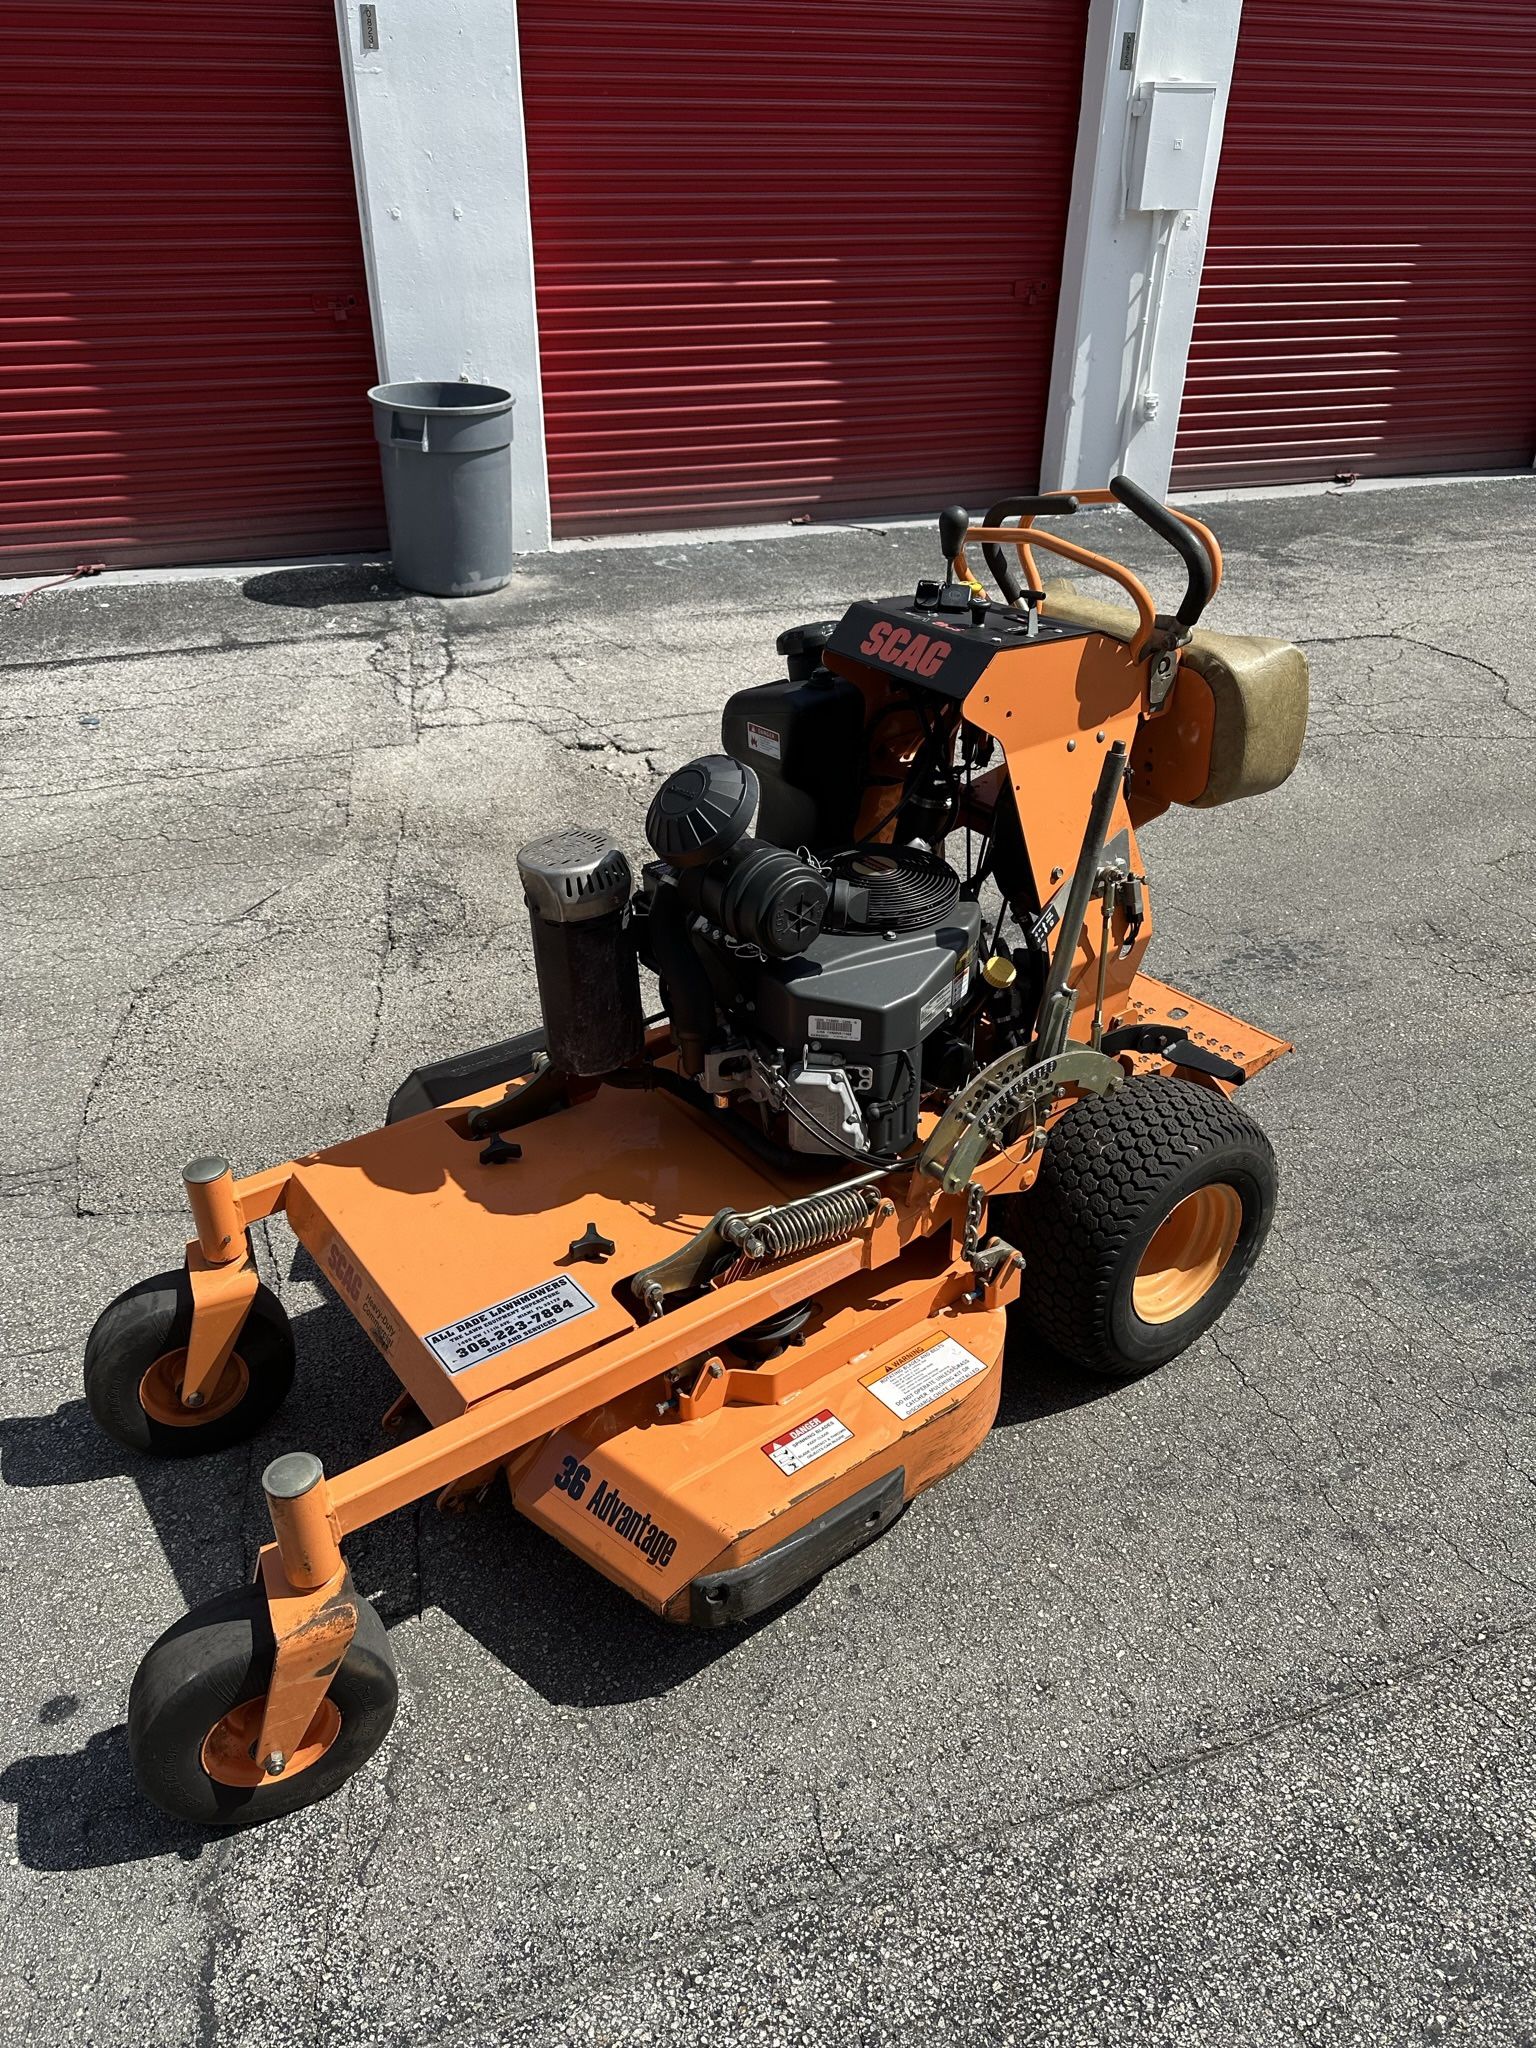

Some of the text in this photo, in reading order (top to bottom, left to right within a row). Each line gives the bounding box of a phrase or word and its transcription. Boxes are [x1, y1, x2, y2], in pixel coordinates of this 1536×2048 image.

[366, 9, 374, 44] 0823
[859, 620, 953, 678] SCAG
[328, 1243, 363, 1302] SCAG
[360, 1303, 394, 1349] Commercial
[365, 1293, 396, 1337] Heavy-Duty
[431, 1279, 566, 1343] ALL DADE LAWNMOWERS
[449, 1290, 559, 1342] THE LAWN EQUIPMENT SUPERSTORE
[456, 1299, 572, 1357] 305-223-7884
[517, 1309, 533, 1318] MIAMI
[487, 1318, 556, 1352] SOLD AND SERVICED
[879, 1368, 903, 1383] ROTATING
[919, 1351, 930, 1359] AND
[891, 1346, 924, 1367] WARNING
[902, 1393, 913, 1401] NOT
[913, 1379, 935, 1394] OPERATE
[905, 1396, 933, 1415] DISCHARGE
[789, 1418, 820, 1438] DANGER
[792, 1421, 834, 1447] SPINNING BLADES
[554, 1455, 678, 1568] 36 Advantage
